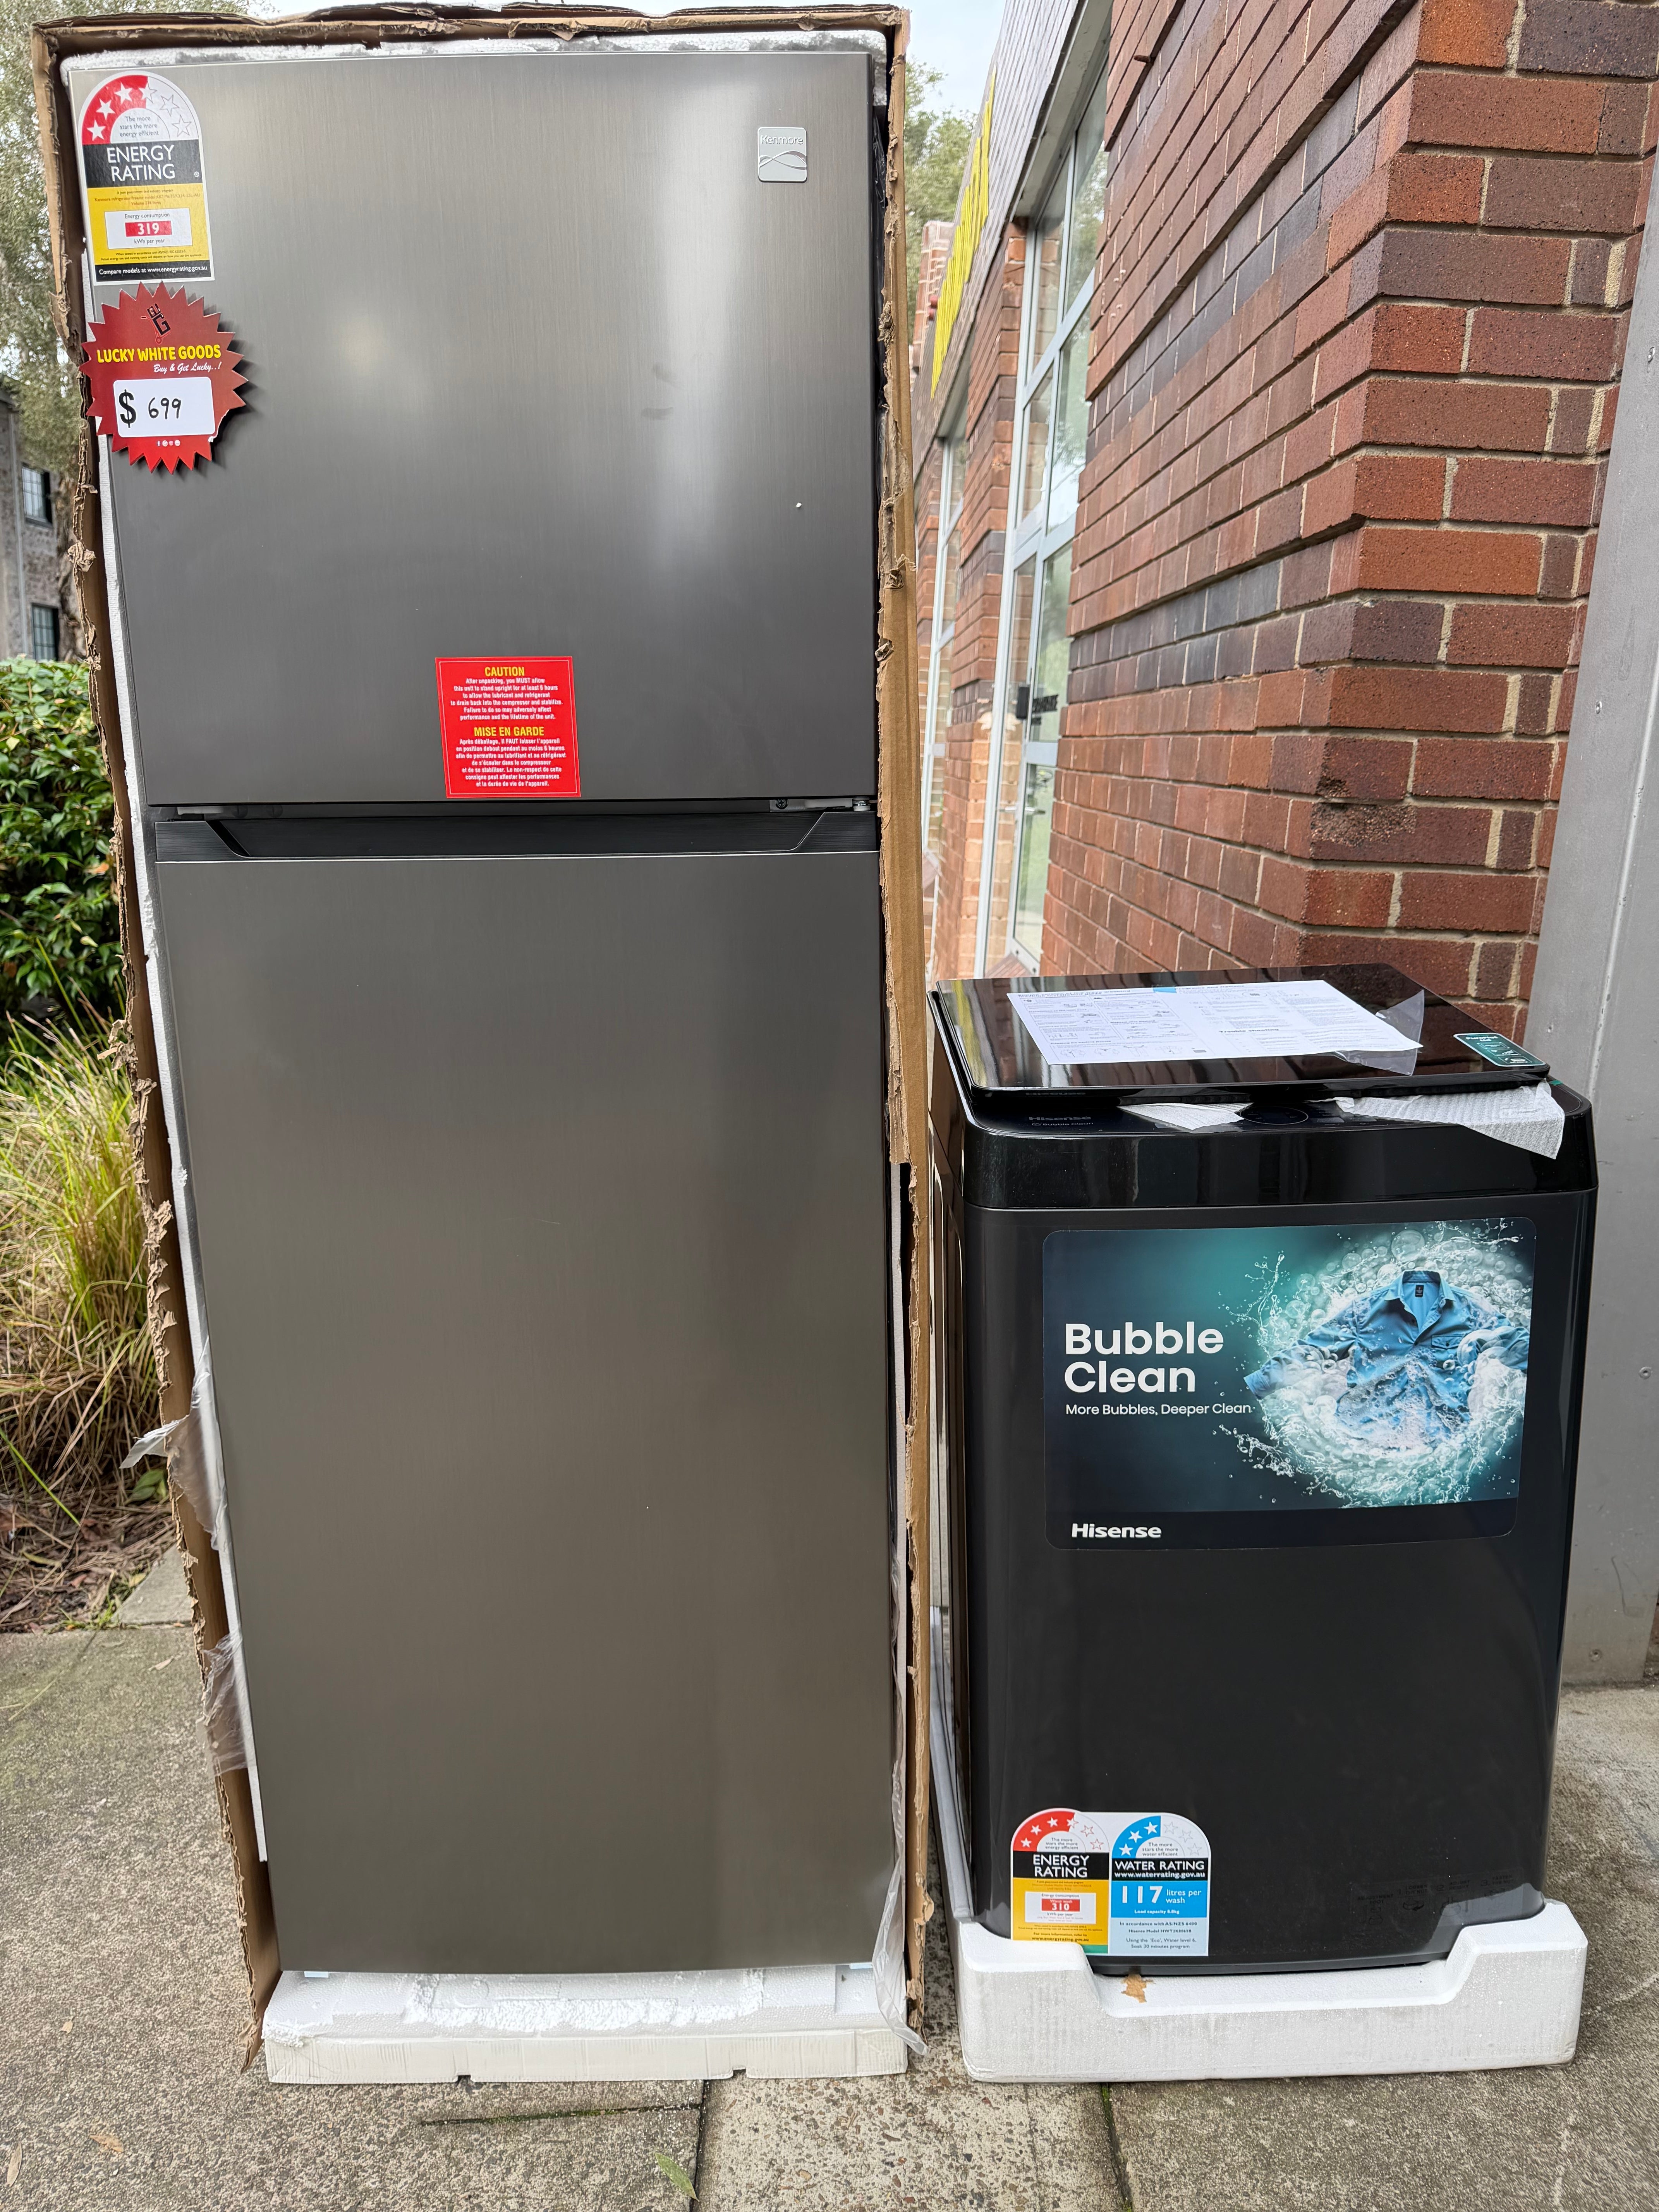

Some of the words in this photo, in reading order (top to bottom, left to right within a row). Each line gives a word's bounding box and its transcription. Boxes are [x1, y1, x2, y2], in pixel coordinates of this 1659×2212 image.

[760, 135, 804, 144] Kenmore
[107, 144, 174, 163] ENERGY
[112, 164, 175, 181] RATING
[137, 222, 159, 235] 319
[97, 349, 134, 363] LUCKY
[137, 347, 176, 361] WHITE
[178, 345, 221, 359] GOODS
[153, 364, 167, 373] Buy
[177, 364, 189, 374] Get
[118, 389, 137, 428] $
[148, 397, 182, 419] 699
[485, 666, 524, 676] CAUTION
[474, 727, 496, 736] MISE
[499, 727, 510, 736] EN
[514, 726, 544, 736] GARDE
[1066, 1321, 1224, 1354] Bubble
[1065, 1360, 1195, 1392] Clean
[1066, 1404, 1099, 1415] More
[1103, 1404, 1158, 1415] Bubbles,
[1161, 1404, 1209, 1417] Deeper
[1072, 1523, 1161, 1537] Hisense
[1033, 1854, 1089, 1866] ENERGY
[1115, 1861, 1155, 1870] WATER
[1159, 1861, 1204, 1870] RATING
[1034, 1866, 1087, 1877] RATING
